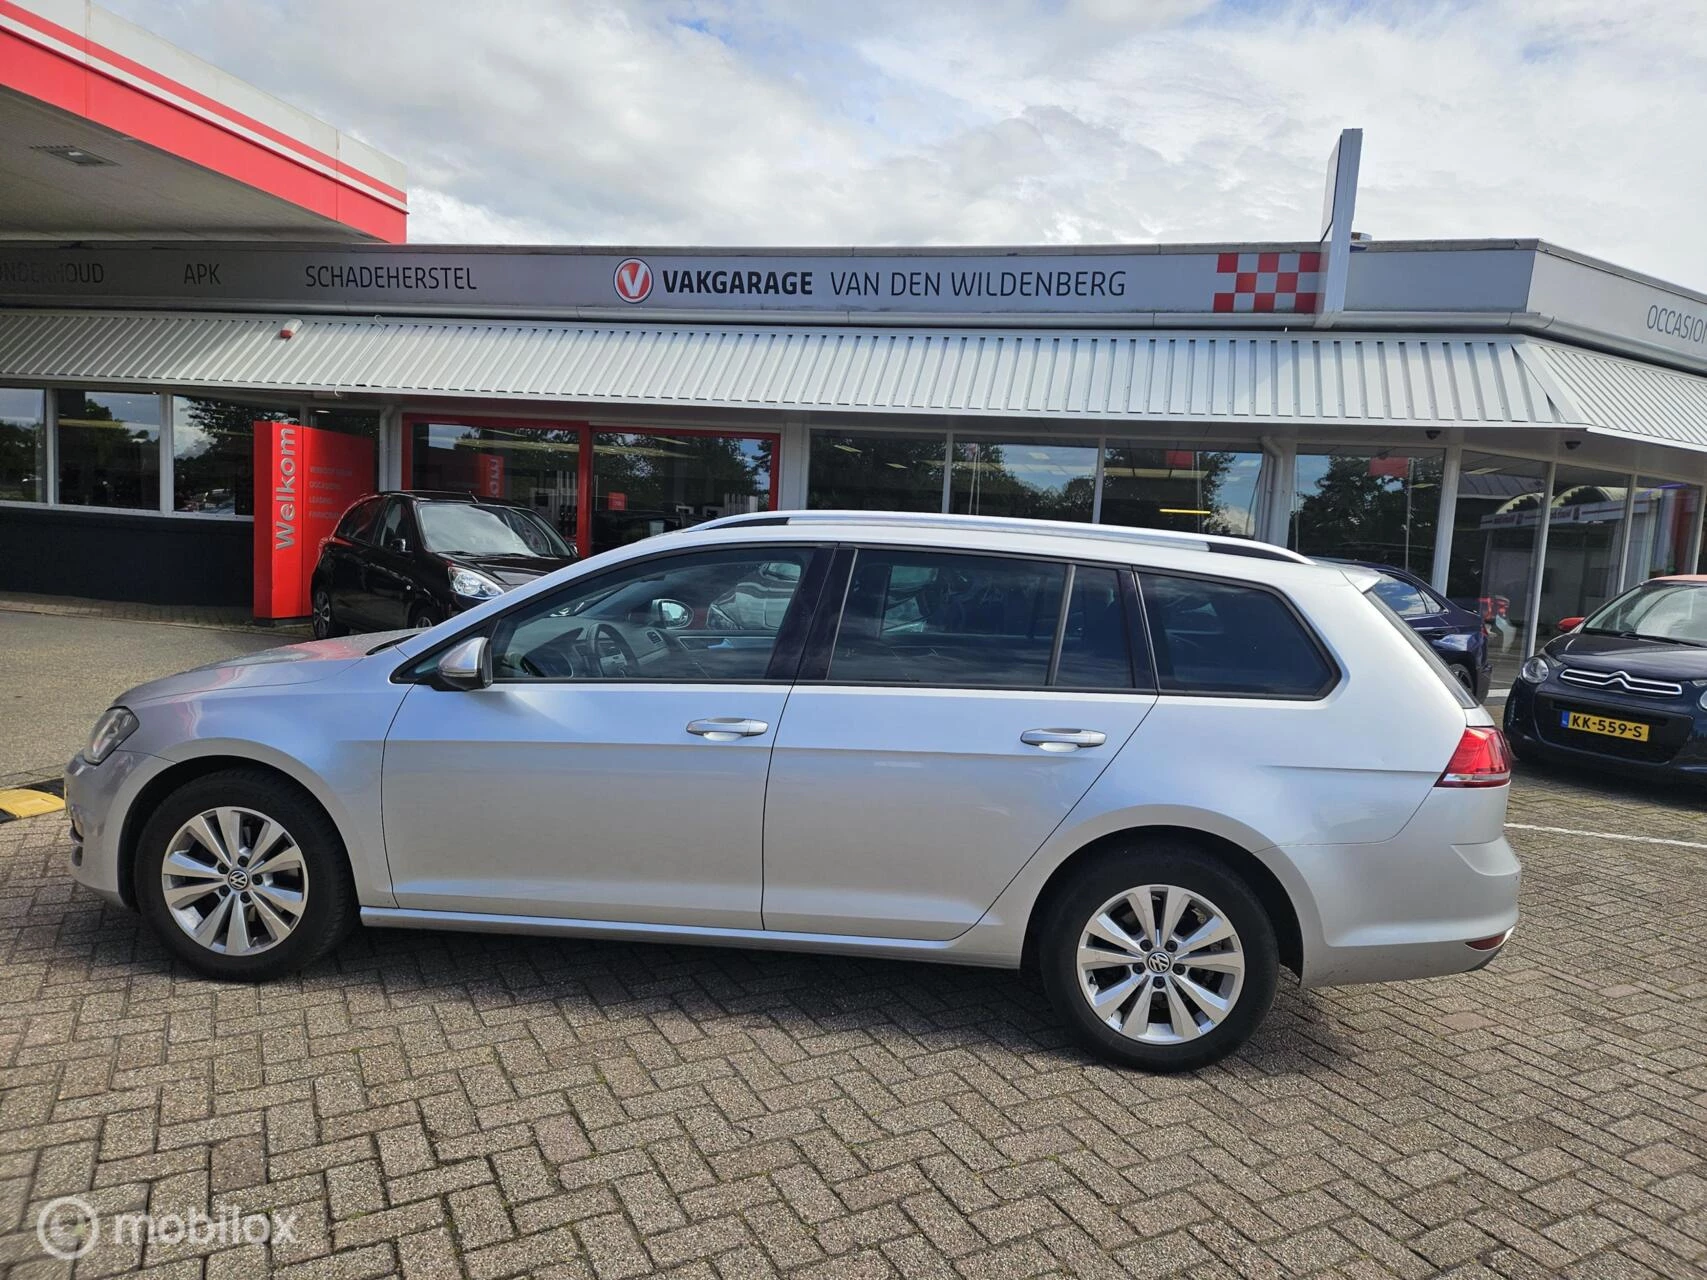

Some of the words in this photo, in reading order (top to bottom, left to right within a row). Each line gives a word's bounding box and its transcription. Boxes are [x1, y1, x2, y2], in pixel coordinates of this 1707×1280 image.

[183, 263, 221, 285] APK
[305, 265, 477, 290] SCHADEHERSTEL
[662, 270, 813, 295] VAKGARAGE
[830, 271, 880, 296] VAN
[890, 271, 941, 296] DEN
[951, 271, 1127, 297] WILDENBERG
[276, 428, 296, 549] Welkom
[1572, 714, 1643, 738] KK-559-S
